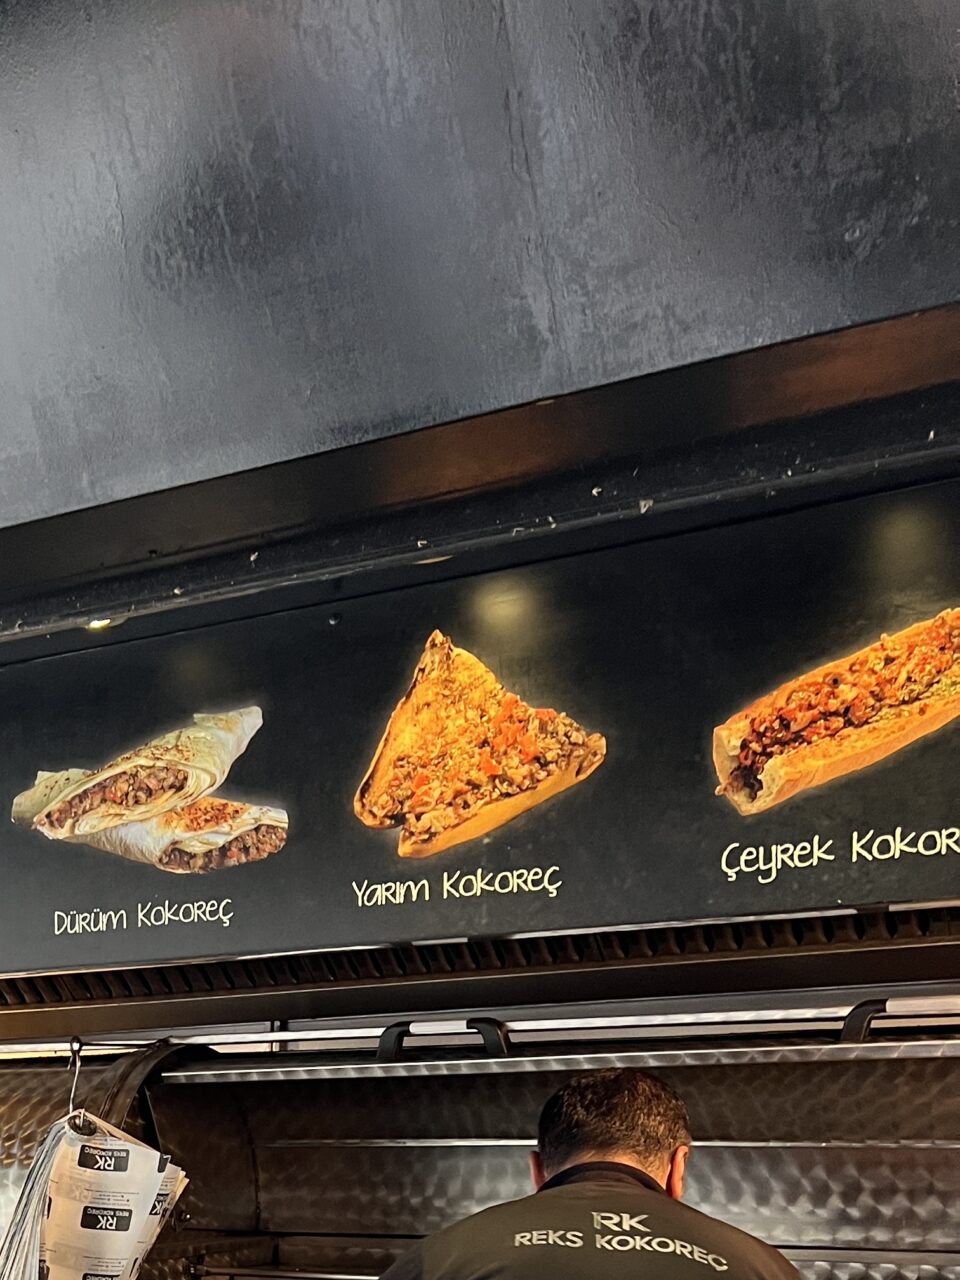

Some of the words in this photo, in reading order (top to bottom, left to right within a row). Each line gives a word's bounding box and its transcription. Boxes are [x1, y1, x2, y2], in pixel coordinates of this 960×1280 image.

[721, 835, 835, 883] Çeyrek
[442, 865, 563, 898] Kokoreç
[53, 908, 127, 936] Dürüm
[138, 898, 234, 928] Kokoreç
[93, 1155, 116, 1171] RK
[96, 1215, 118, 1230] RK
[592, 1211, 652, 1233] RK
[514, 1230, 584, 1248] REKS
